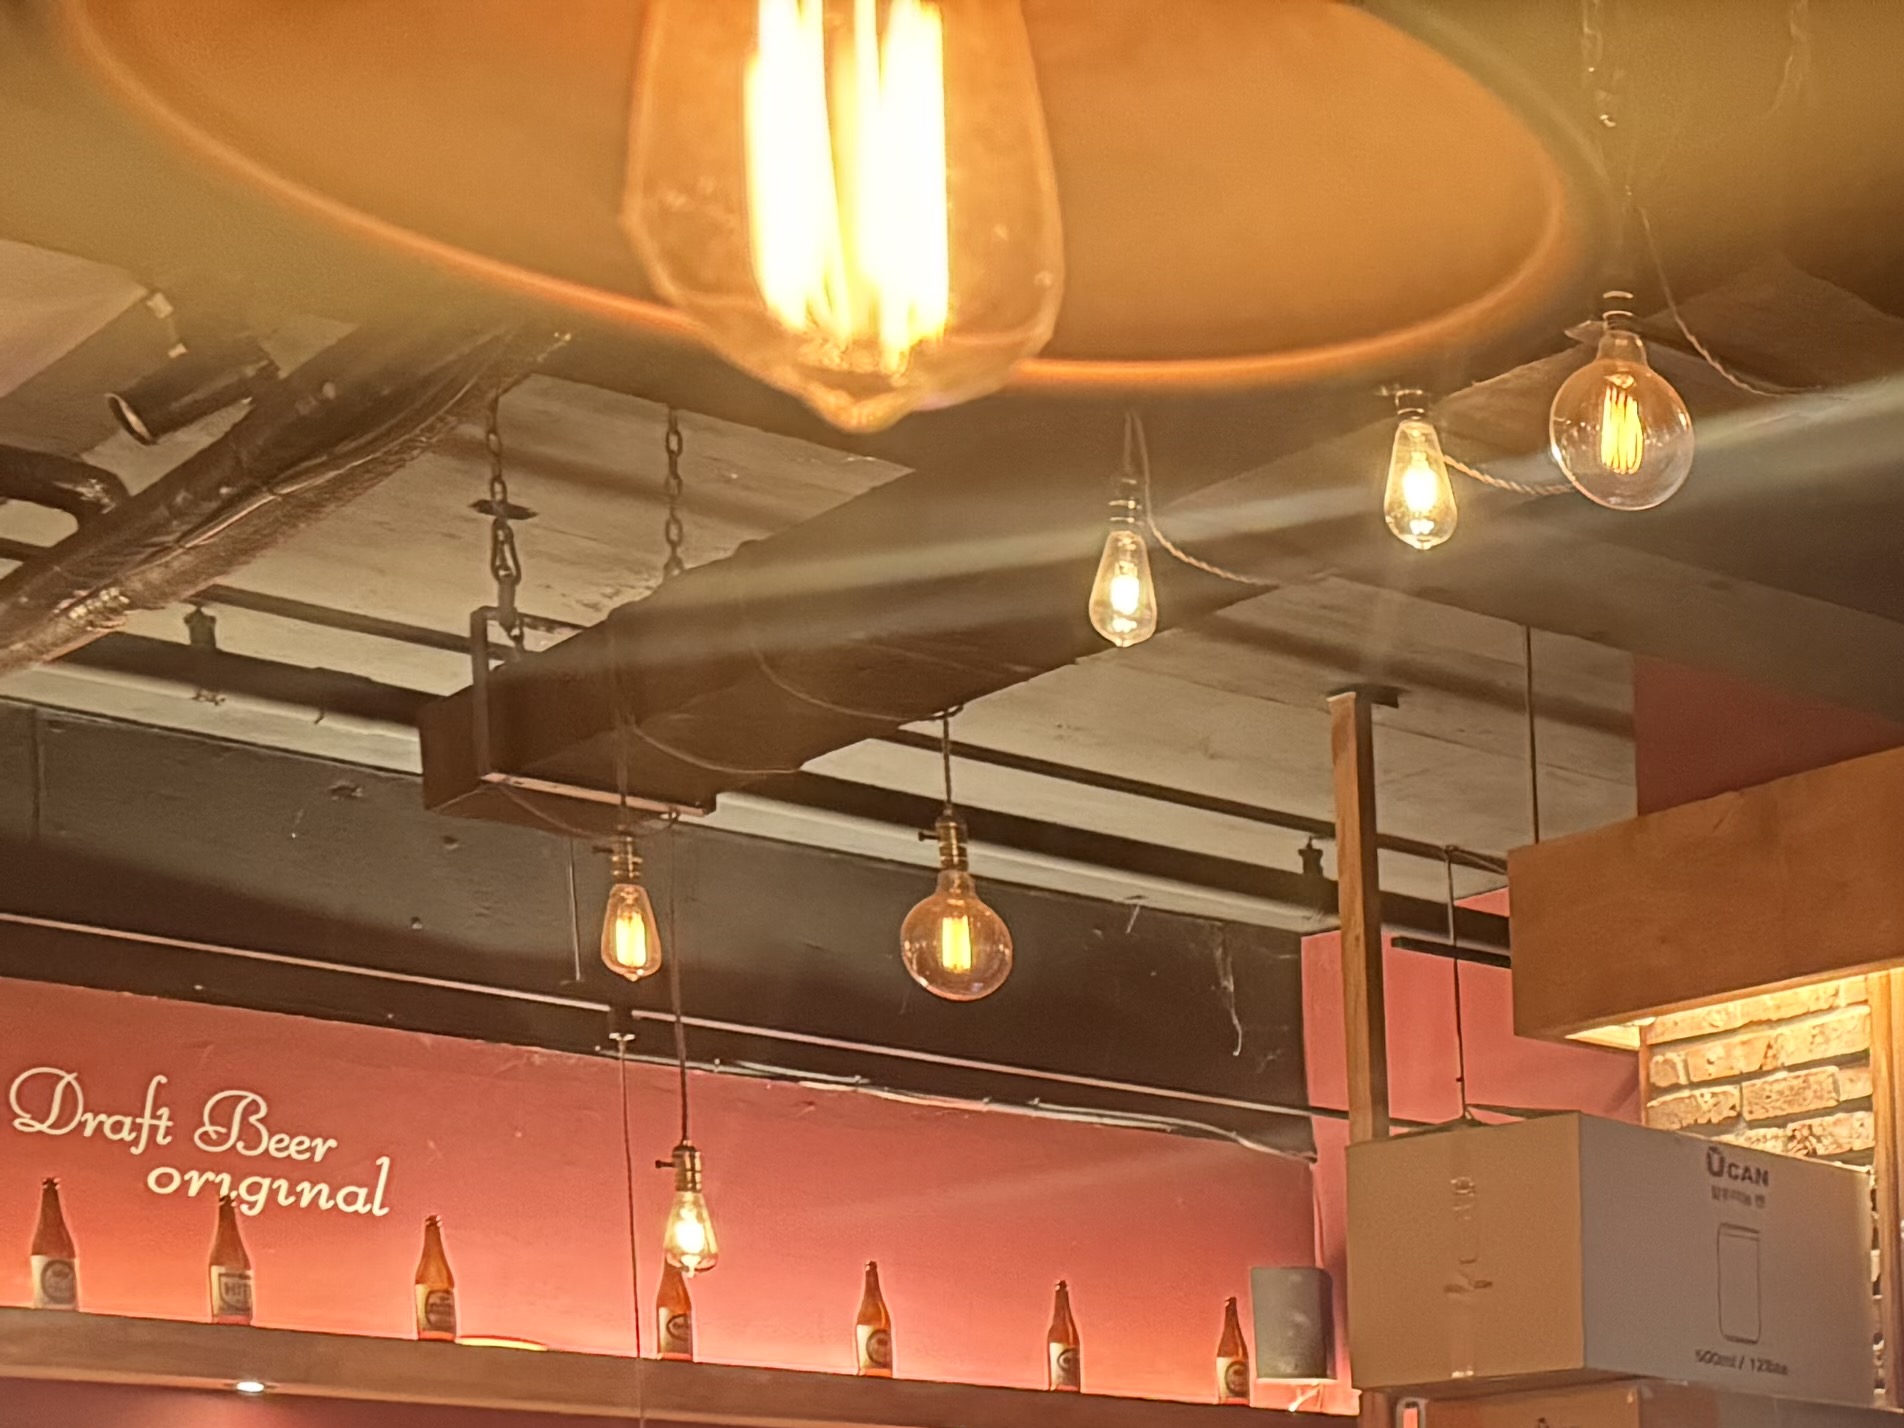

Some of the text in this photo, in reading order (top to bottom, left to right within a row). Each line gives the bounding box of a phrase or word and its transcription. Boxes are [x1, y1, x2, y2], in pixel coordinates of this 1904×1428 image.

[8, 1065, 339, 1164] Draft Beer
[146, 1155, 392, 1218] original
